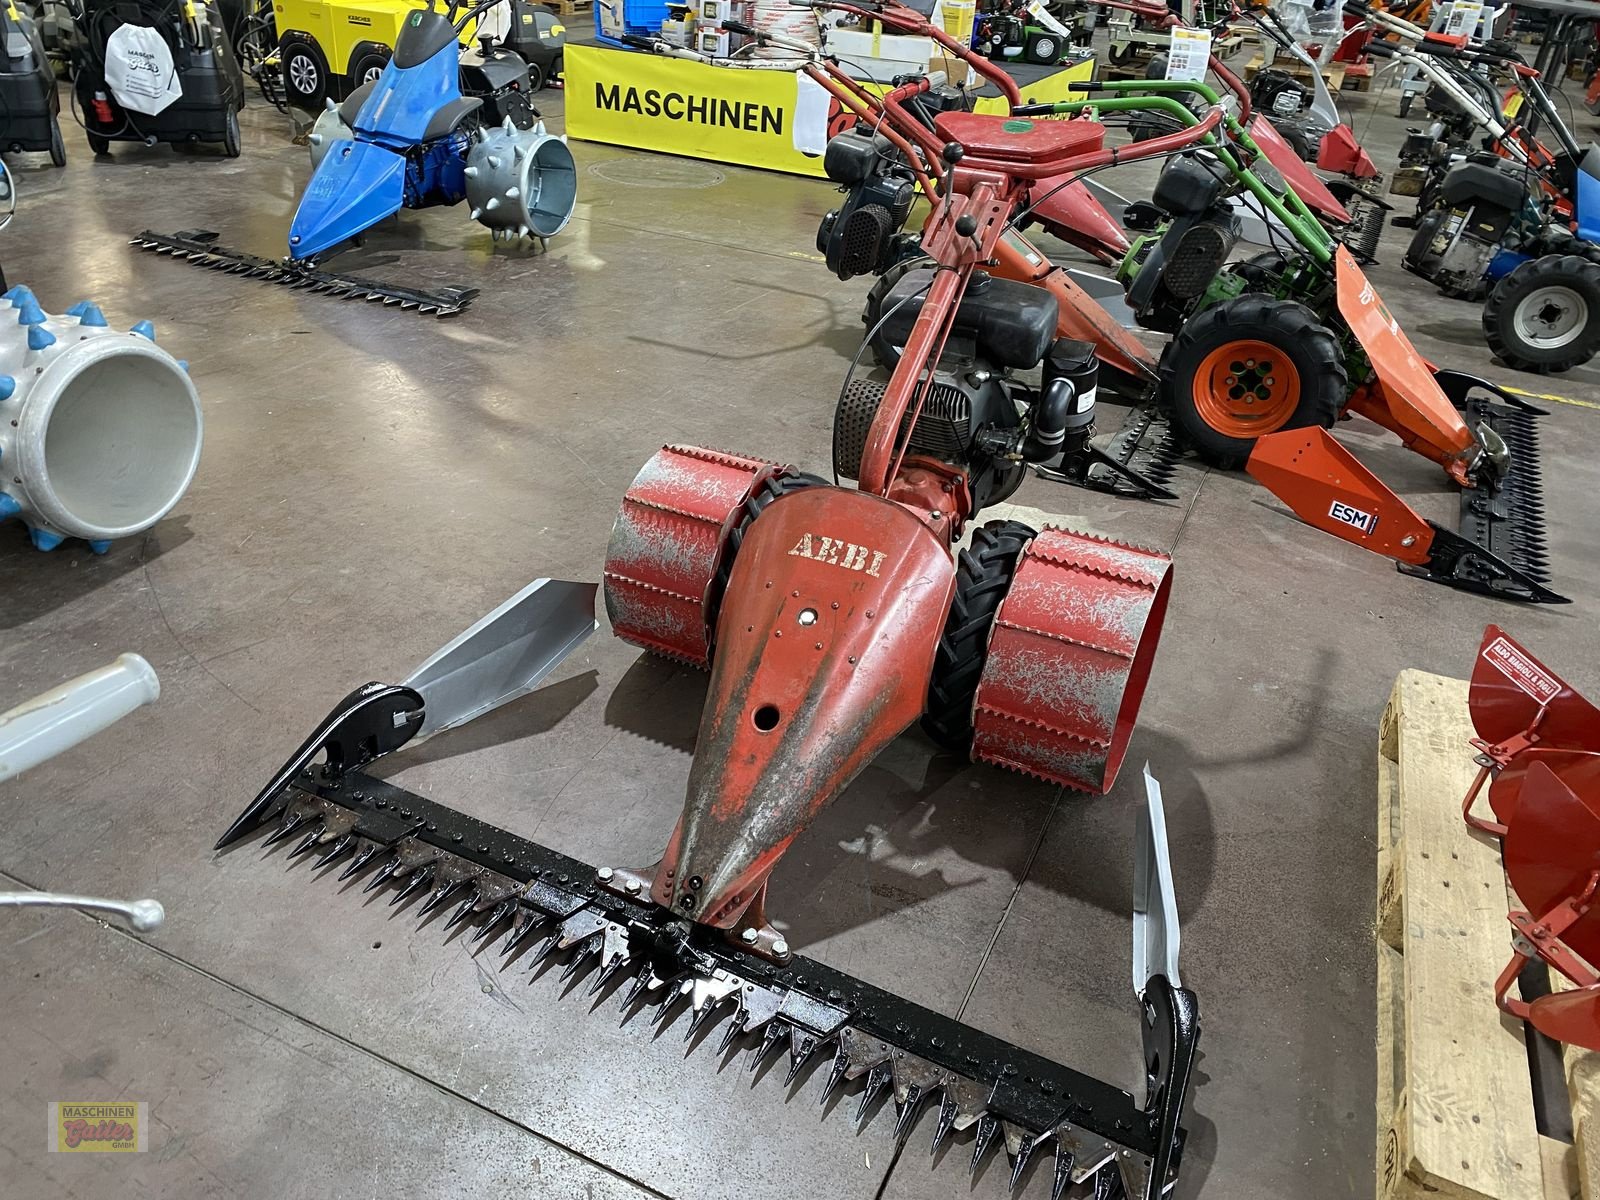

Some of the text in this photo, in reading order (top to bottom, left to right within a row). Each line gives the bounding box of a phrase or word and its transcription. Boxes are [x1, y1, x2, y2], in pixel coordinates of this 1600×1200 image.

[595, 82, 784, 136] MASCHINEN
[1331, 503, 1368, 528] ESM
[787, 532, 888, 579] AEBI
[1493, 644, 1510, 659] ALDO
[1536, 679, 1555, 695] FIGLI
